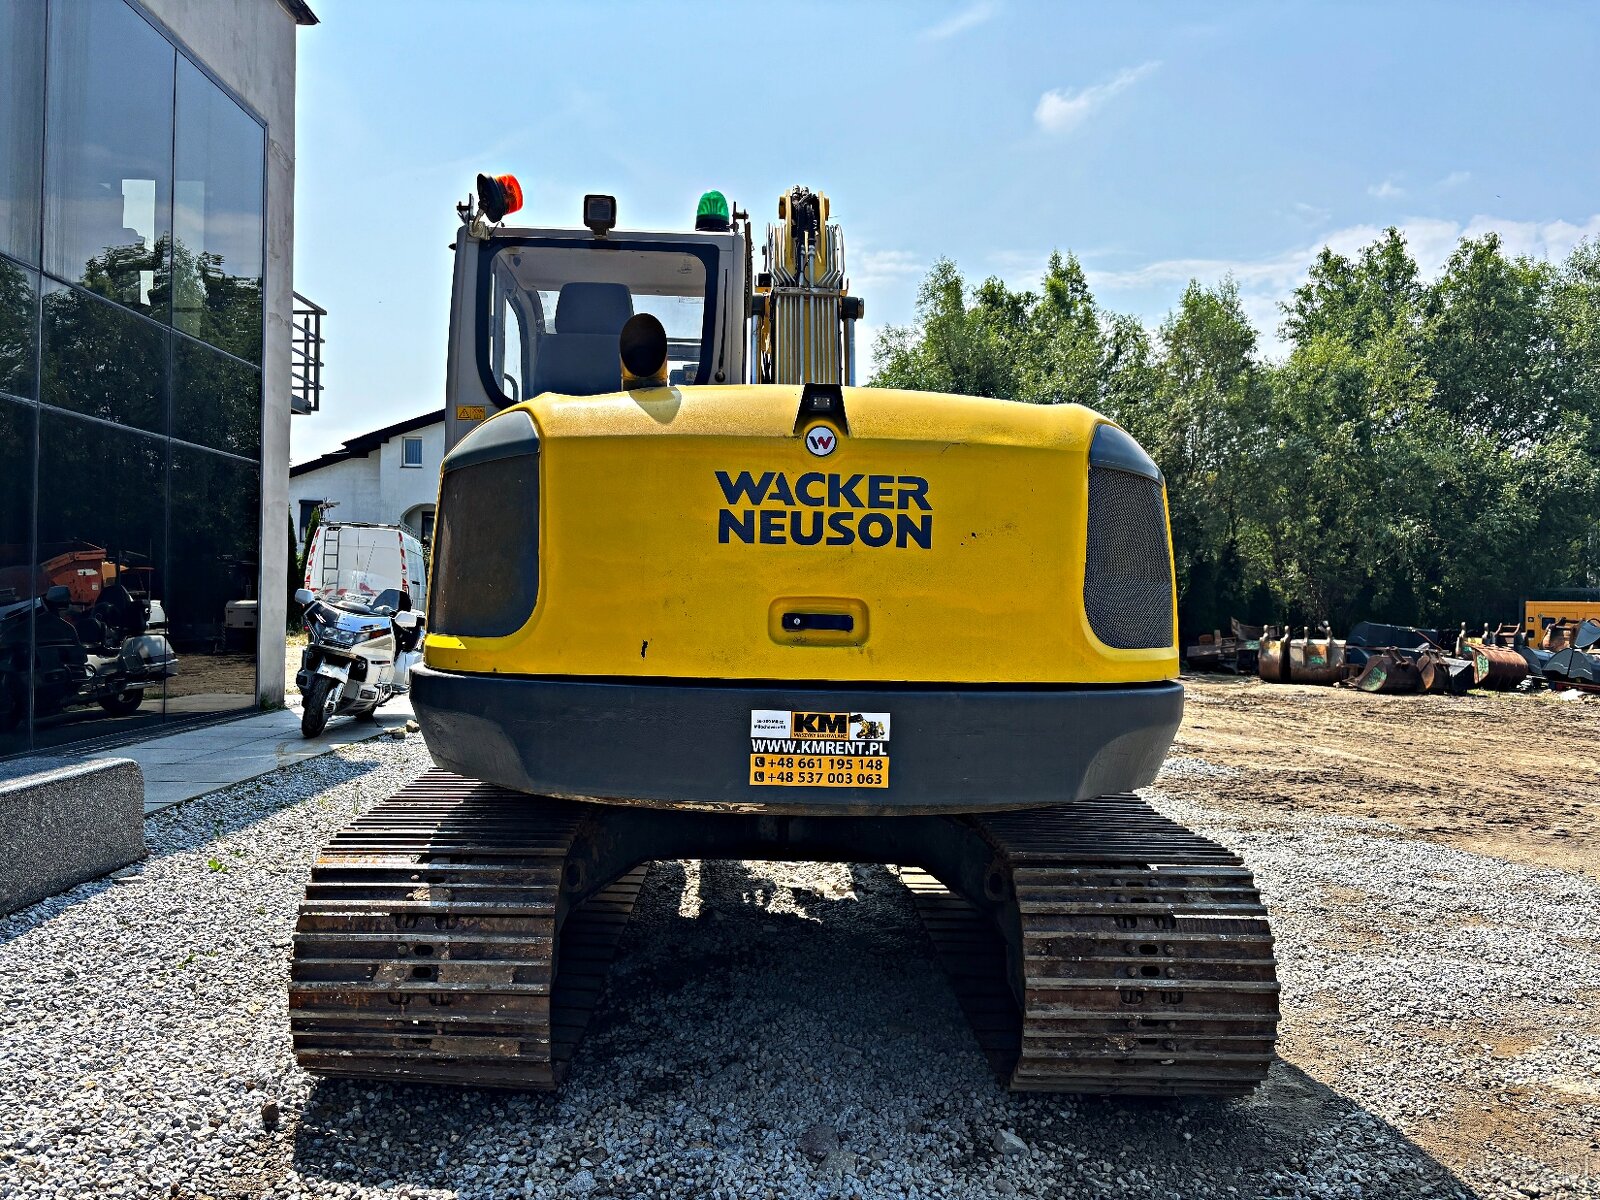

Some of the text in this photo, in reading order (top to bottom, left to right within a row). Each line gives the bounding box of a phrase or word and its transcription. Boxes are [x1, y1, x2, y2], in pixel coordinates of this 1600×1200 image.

[714, 470, 933, 511] WACKER
[718, 508, 933, 550] NEUSON
[793, 713, 848, 733] KM
[751, 738, 887, 756] WWW.KMRENT.PL
[767, 757, 883, 771] +48 661 195 148
[767, 771, 882, 785] +48 537 003 063
